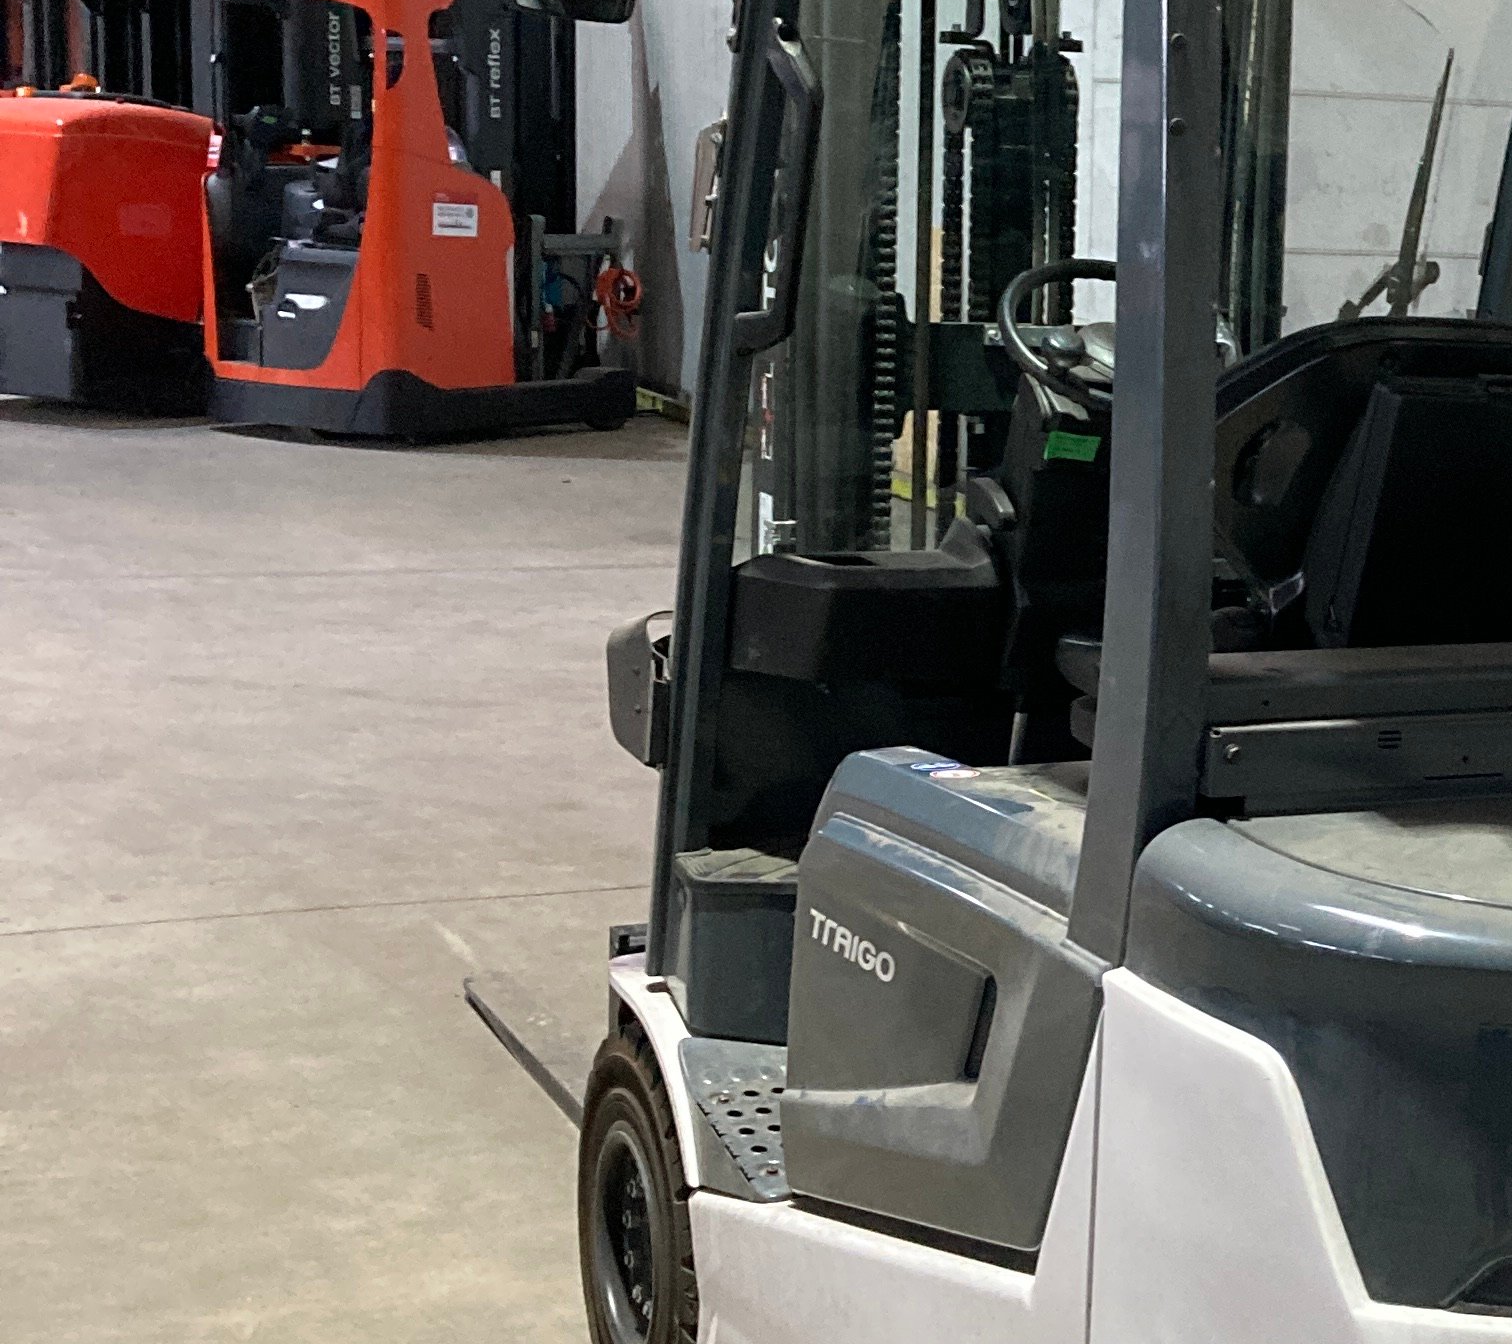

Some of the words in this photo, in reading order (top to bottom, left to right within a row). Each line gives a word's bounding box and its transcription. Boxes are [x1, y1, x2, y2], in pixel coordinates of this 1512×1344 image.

[328, 11, 341, 78] vector
[487, 28, 501, 88] reflex
[329, 83, 341, 106] BT
[489, 95, 501, 118] BT
